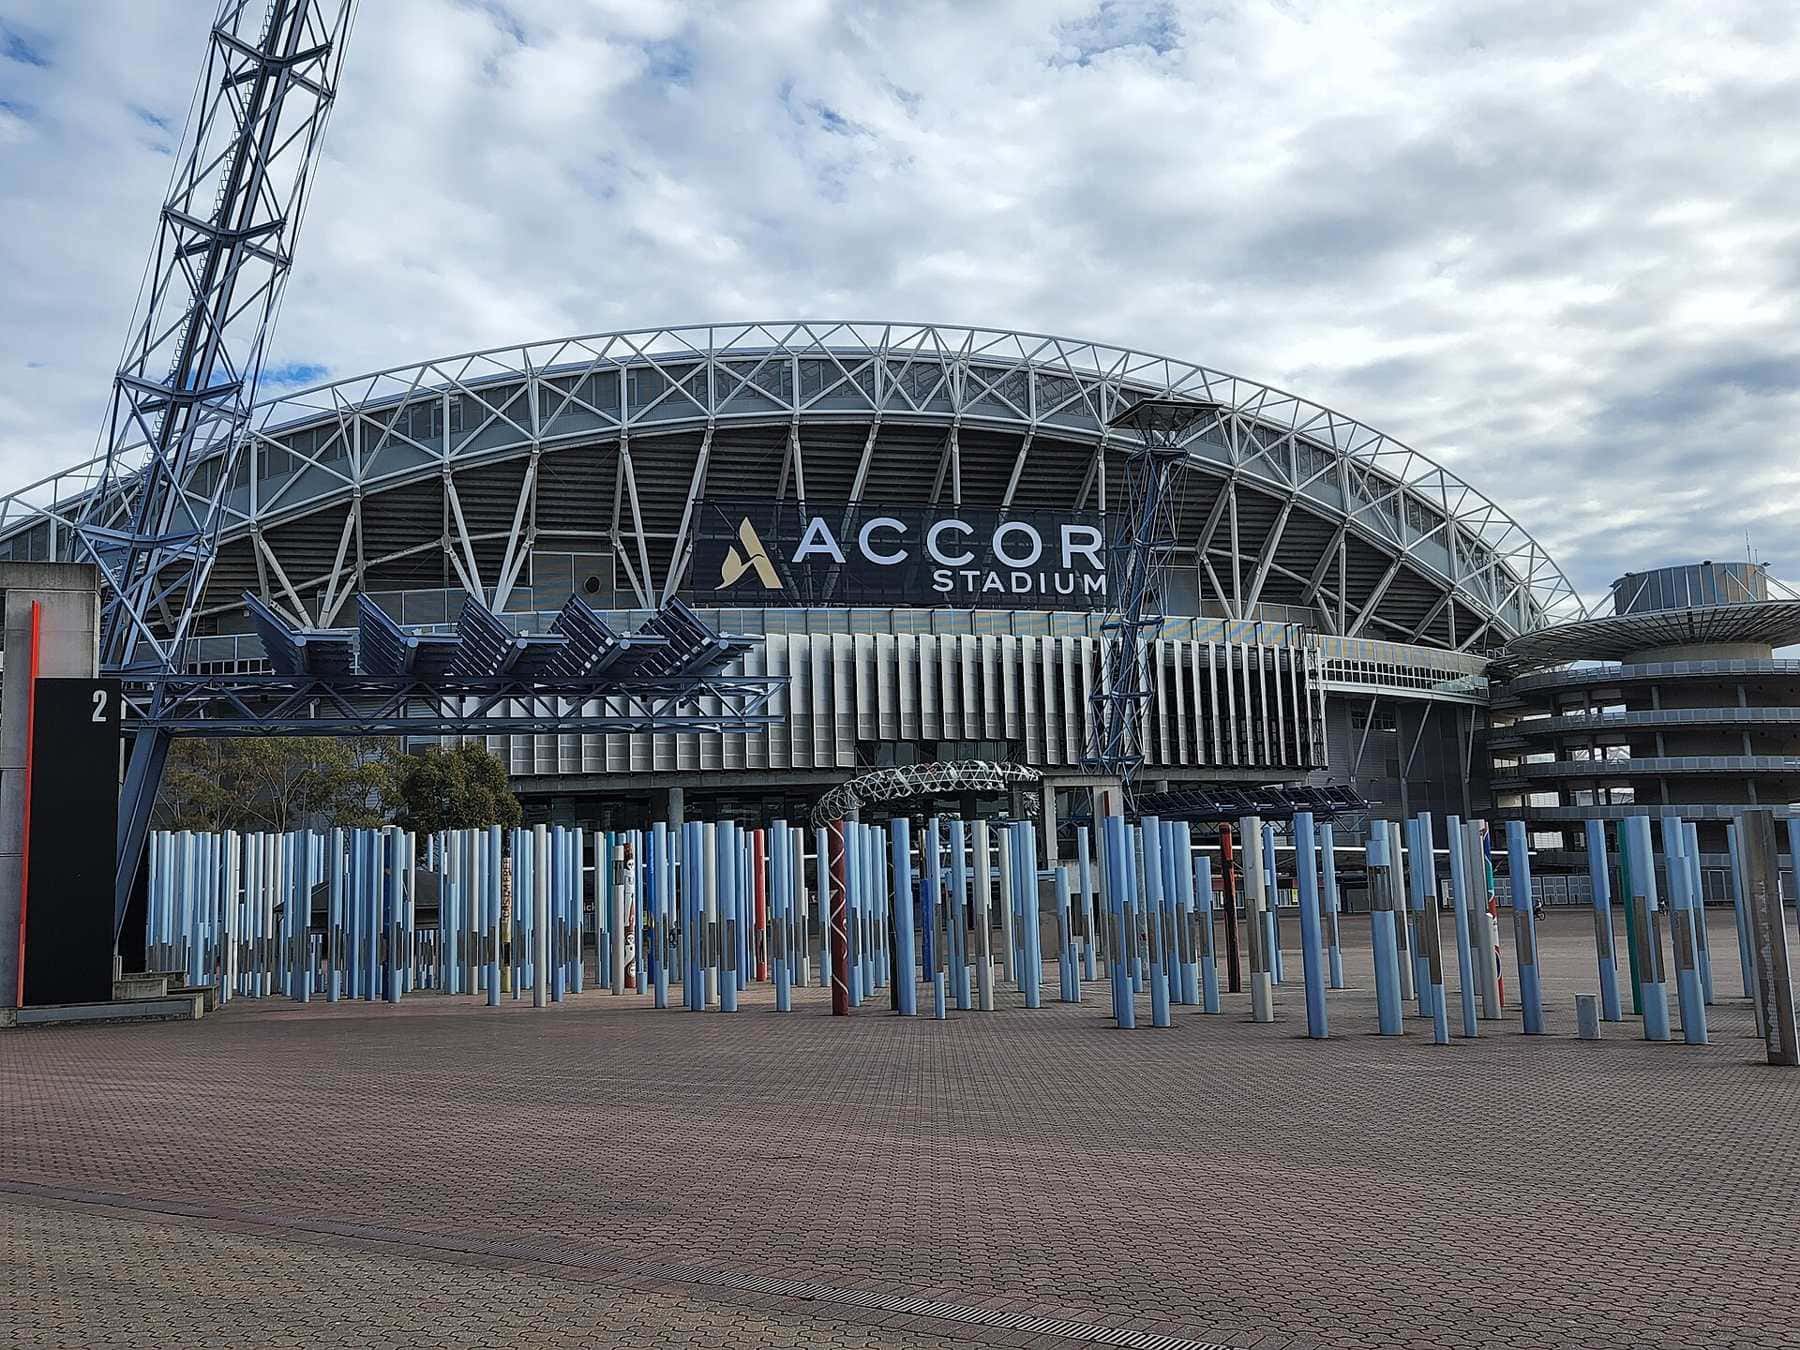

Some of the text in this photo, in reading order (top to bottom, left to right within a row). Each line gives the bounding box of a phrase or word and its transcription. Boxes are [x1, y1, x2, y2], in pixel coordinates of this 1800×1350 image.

[792, 516, 1106, 570] ACCOR
[932, 570, 1107, 595] STADIUM
[92, 690, 107, 722] 2
